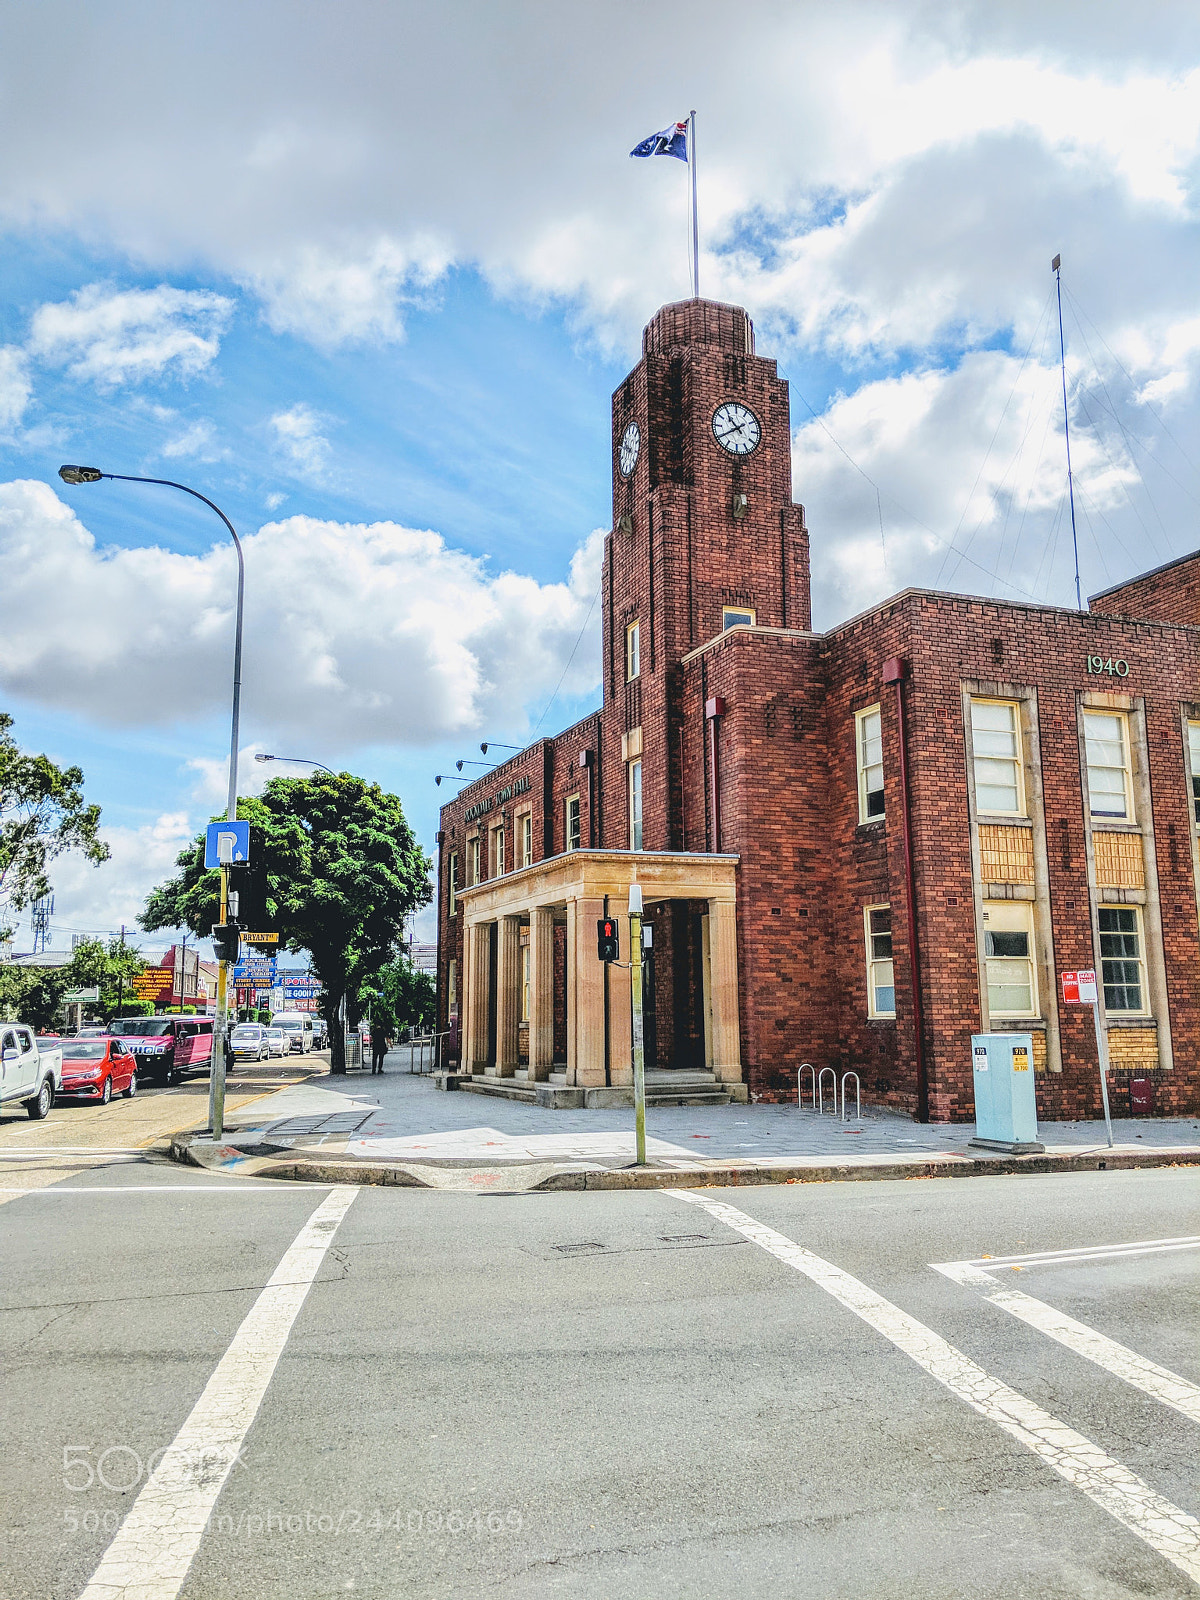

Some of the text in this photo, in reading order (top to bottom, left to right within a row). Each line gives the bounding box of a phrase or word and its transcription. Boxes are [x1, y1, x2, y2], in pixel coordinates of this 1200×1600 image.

[1087, 655, 1130, 677] 1940
[495, 785, 512, 807] TOWN
[513, 775, 532, 797] HALL
[243, 933, 270, 941] BRYANT
[293, 989, 311, 997] GOOD
